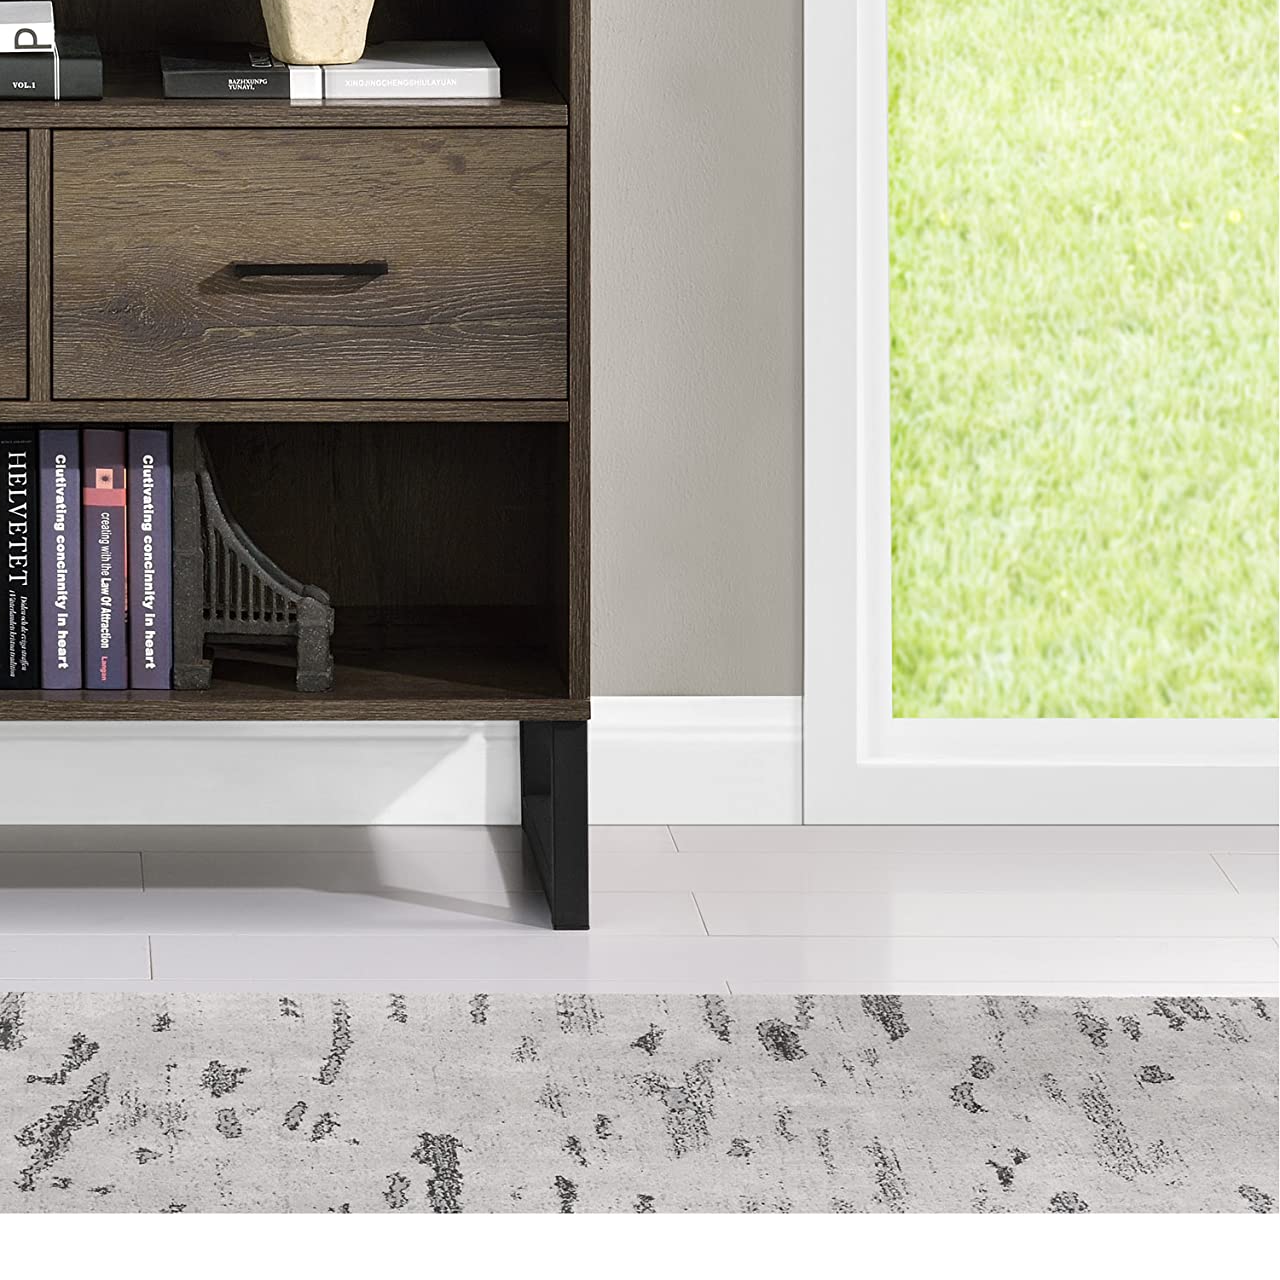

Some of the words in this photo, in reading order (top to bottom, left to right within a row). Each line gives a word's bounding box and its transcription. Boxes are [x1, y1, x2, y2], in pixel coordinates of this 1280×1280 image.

[12, 81, 36, 89] VOL.1
[53, 454, 67, 531] Clutivating
[140, 454, 154, 531] Clutivating
[8, 451, 28, 586] HELVETET
[98, 512, 111, 544] creating
[100, 546, 111, 562] with
[100, 564, 111, 576] the
[55, 534, 68, 610] concinnity
[100, 578, 111, 596] Law
[142, 534, 155, 610] concinnity
[101, 596, 112, 608] Of
[57, 613, 68, 627] in
[101, 608, 112, 650] Attraction
[144, 613, 155, 627] in
[58, 630, 69, 669] heart
[145, 630, 156, 669] heart
